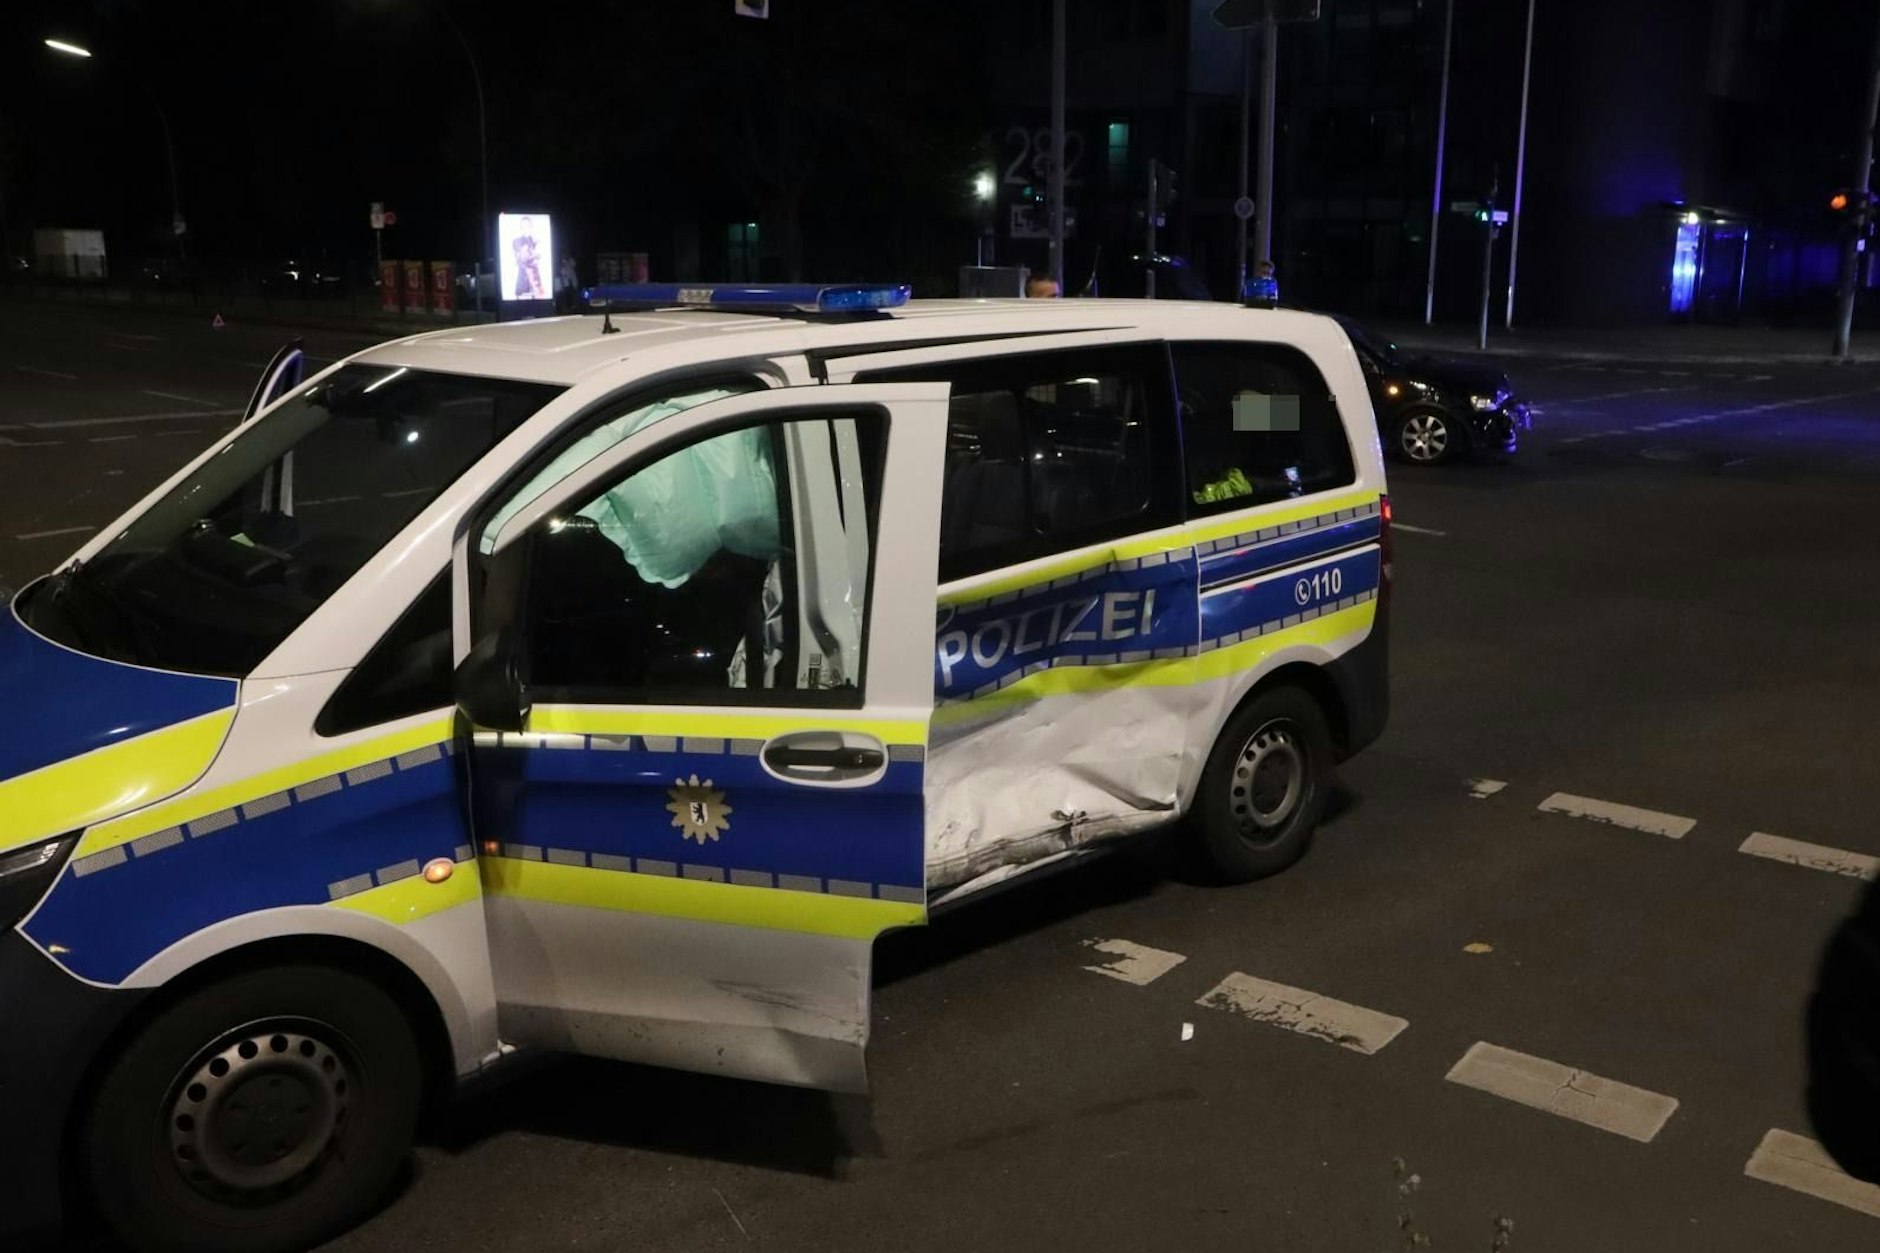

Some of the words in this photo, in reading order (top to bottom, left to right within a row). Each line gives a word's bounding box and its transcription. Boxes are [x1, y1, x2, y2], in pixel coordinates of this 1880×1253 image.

[1003, 125, 1085, 186] 282
[1311, 567, 1342, 601] 110
[936, 588, 1157, 689] POLIZEI
